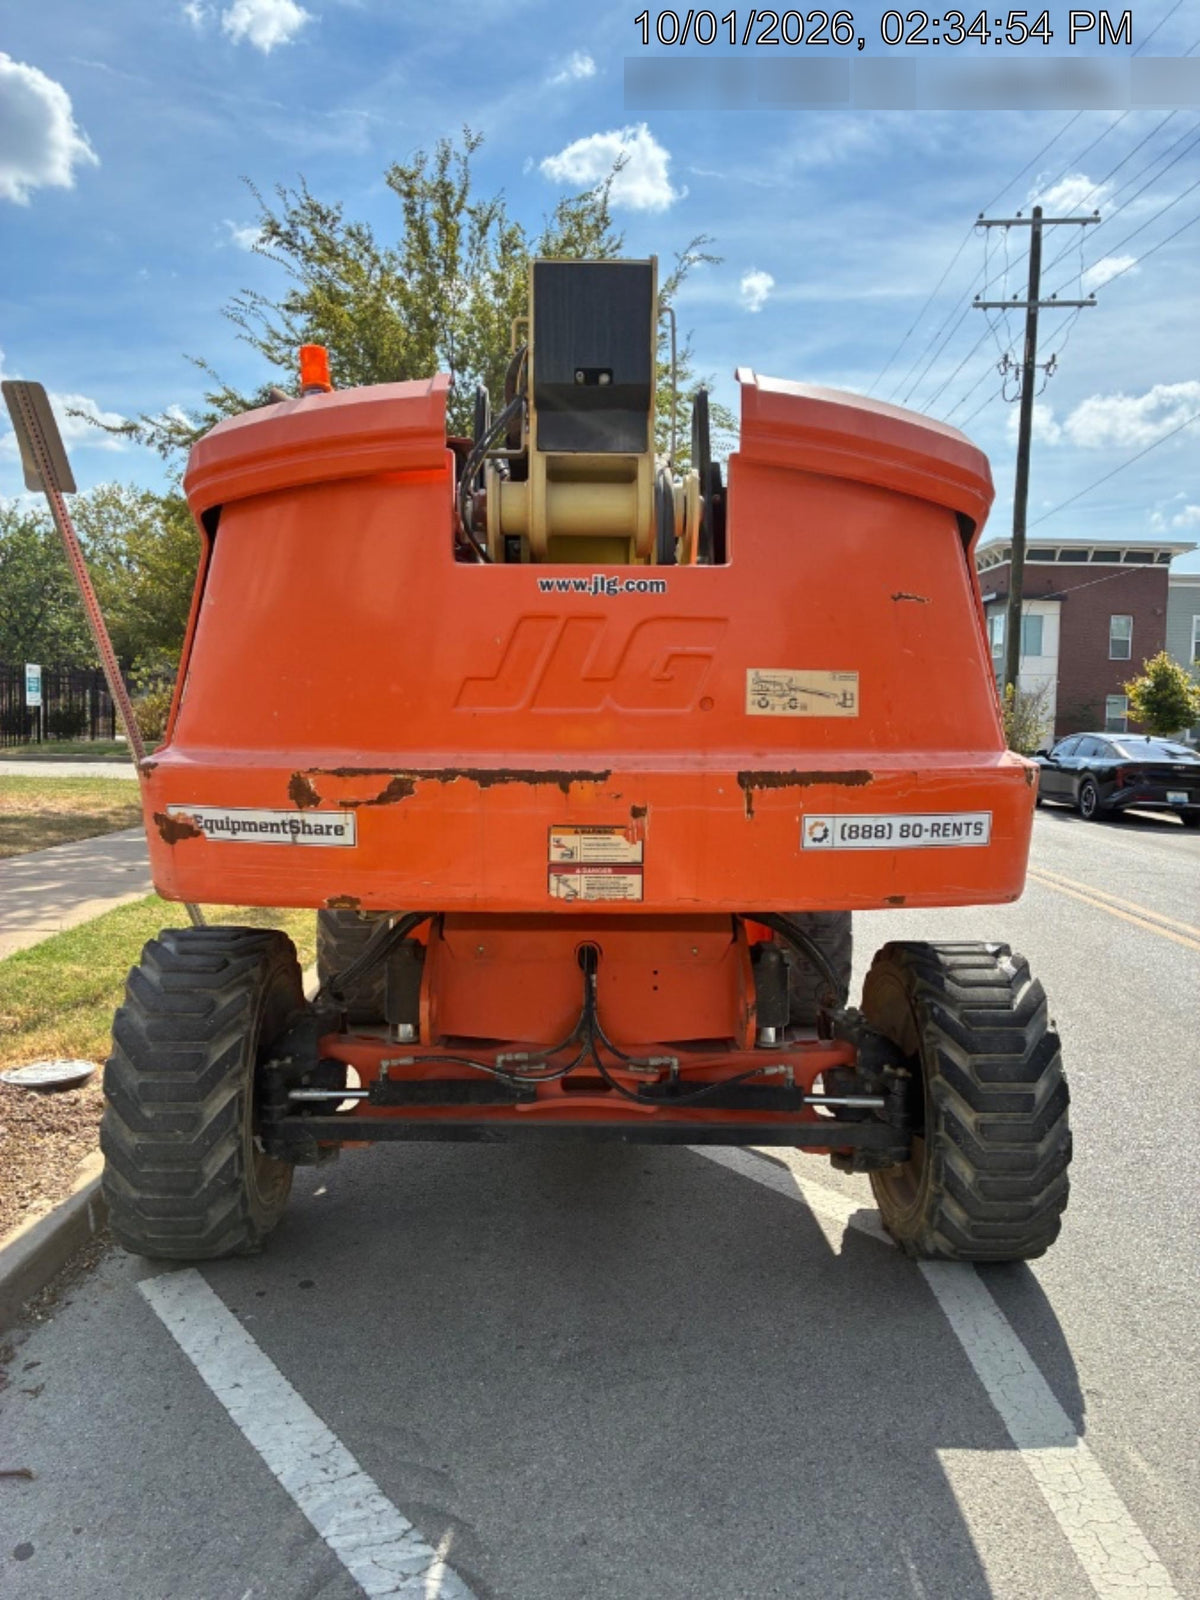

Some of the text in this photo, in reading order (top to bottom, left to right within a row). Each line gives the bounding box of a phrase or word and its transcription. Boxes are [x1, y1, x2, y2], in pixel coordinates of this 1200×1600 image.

[537, 575, 667, 595] www.jlg.com
[453, 614, 729, 713] JLG
[193, 814, 345, 837] EquipmentShare
[840, 821, 985, 842] (888) 80-RENTS
